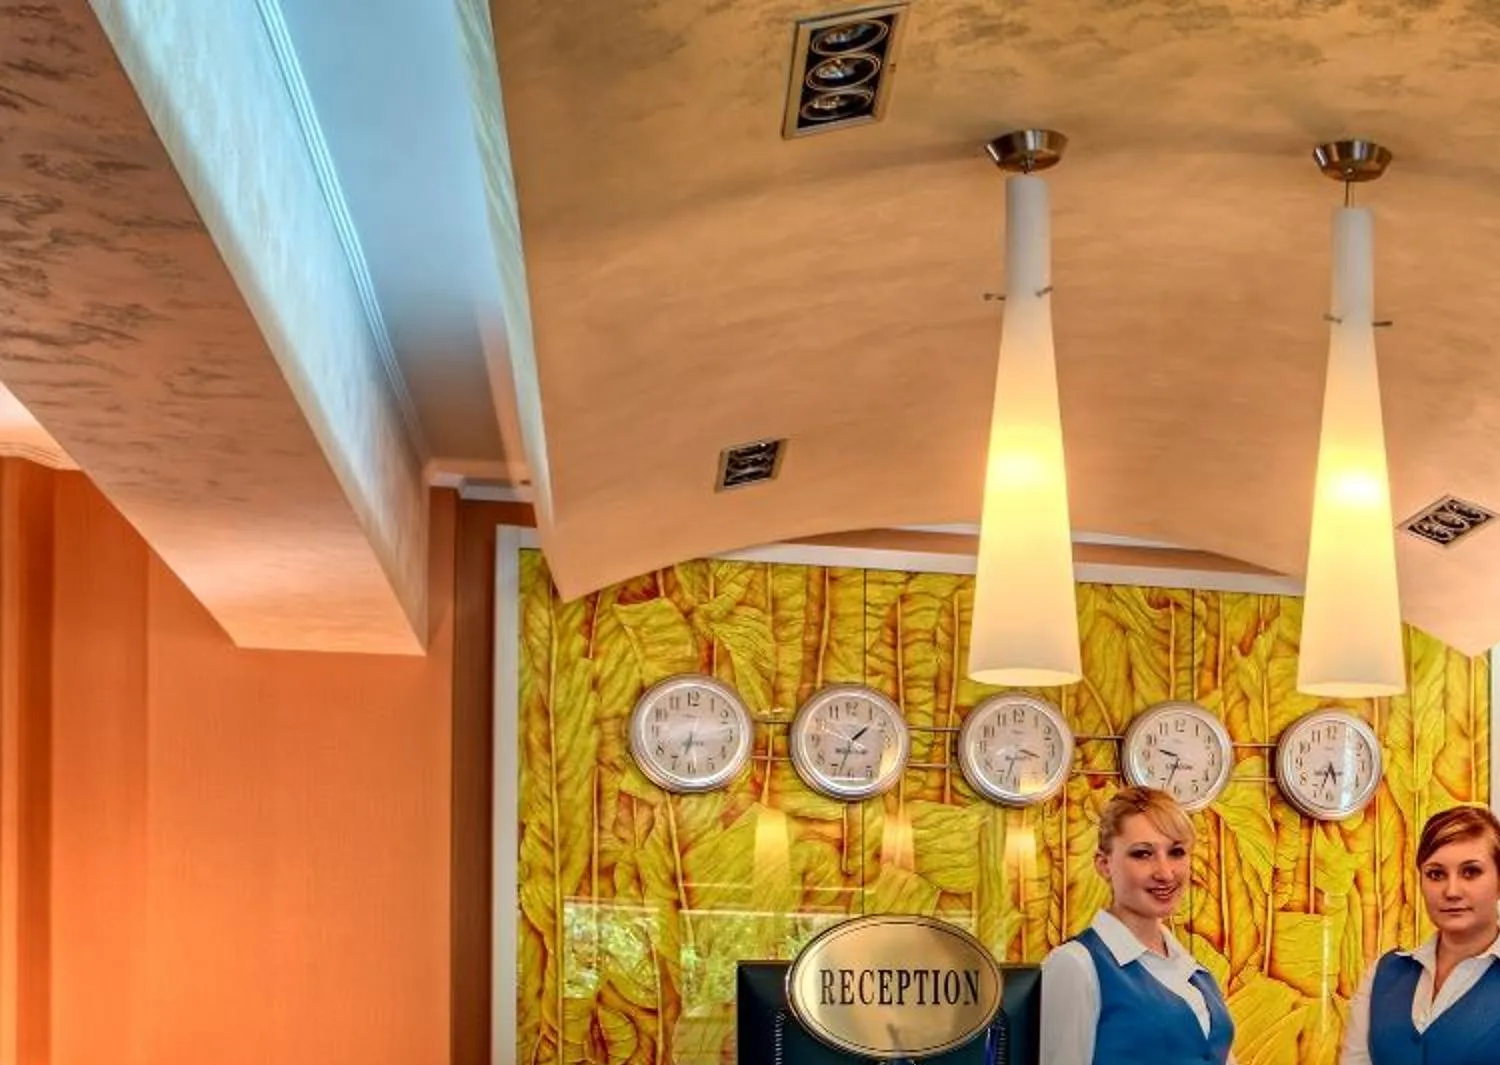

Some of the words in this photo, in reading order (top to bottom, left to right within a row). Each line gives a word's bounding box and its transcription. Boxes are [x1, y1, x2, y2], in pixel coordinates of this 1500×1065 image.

[669, 696, 680, 711] 11
[687, 691, 700, 706] 12
[655, 708, 668, 722] 10
[828, 705, 839, 720] 11
[845, 701, 859, 717] 12
[1012, 708, 1025, 724] 12
[997, 712, 1007, 727] 11
[1175, 719, 1187, 733] 12
[983, 725, 995, 738] 10
[1159, 722, 1169, 736] 11
[1326, 725, 1338, 741] 12
[1147, 734, 1158, 746] 10
[1310, 730, 1321, 744] 11
[1299, 741, 1311, 755] 10
[820, 969, 980, 1005] RECEPTION
